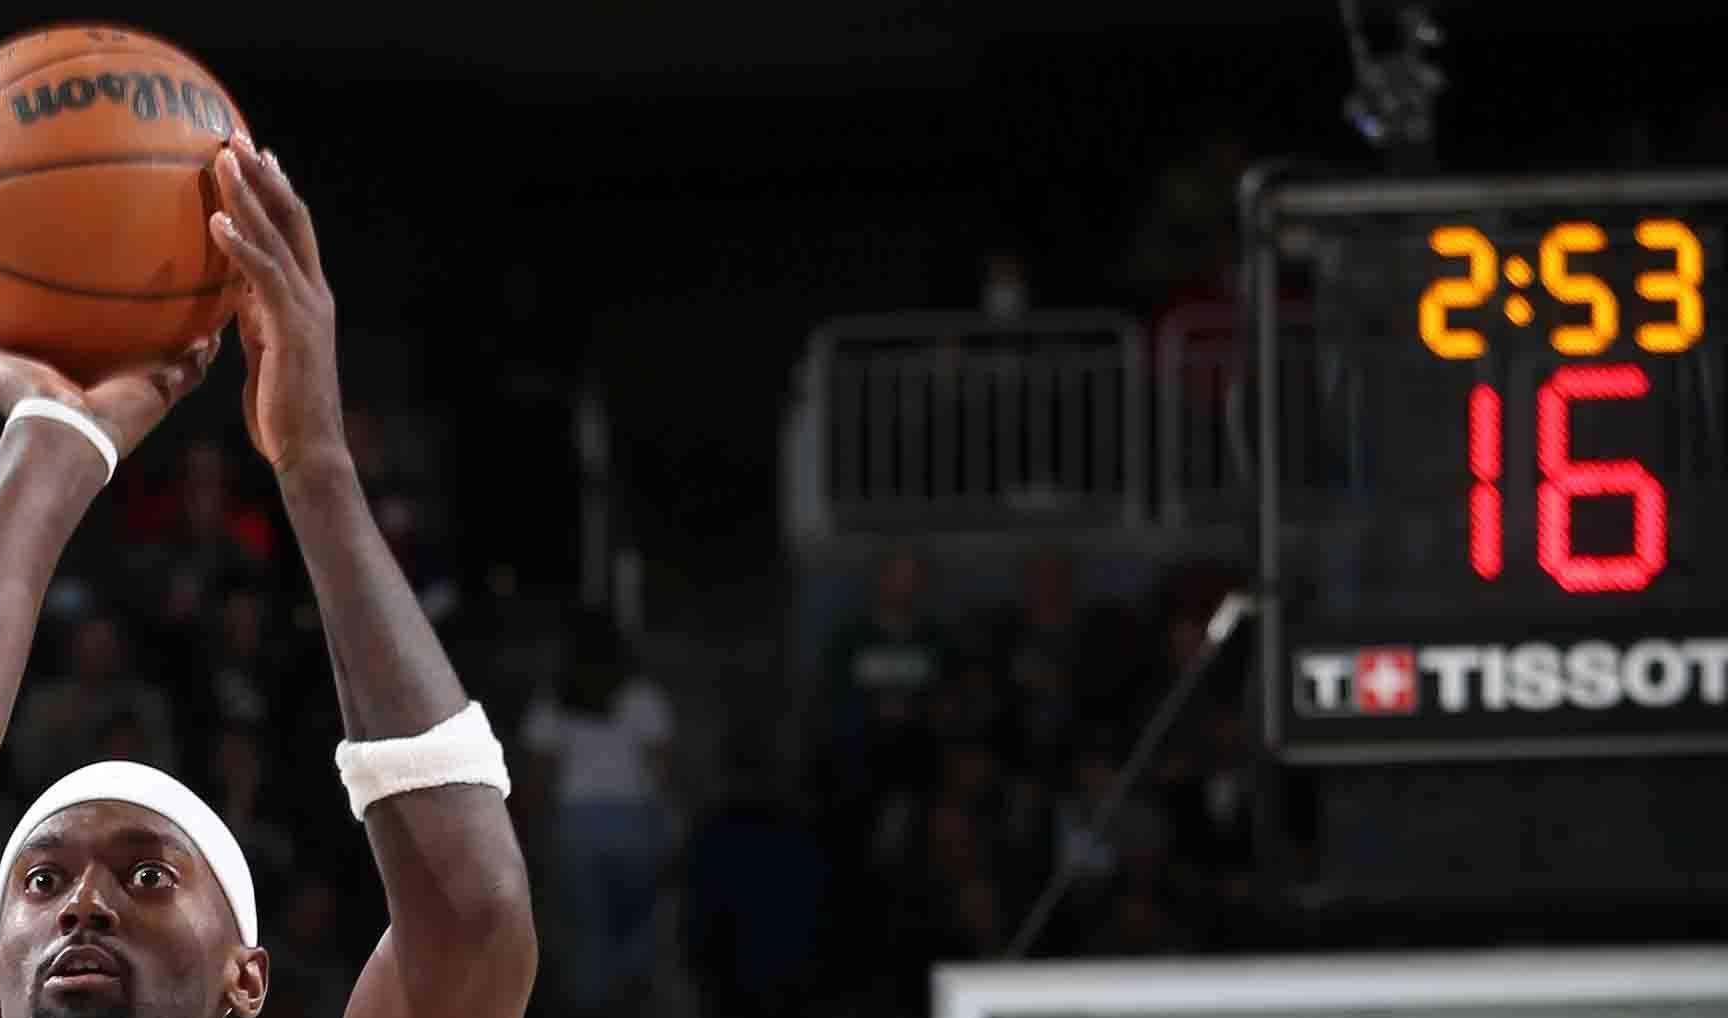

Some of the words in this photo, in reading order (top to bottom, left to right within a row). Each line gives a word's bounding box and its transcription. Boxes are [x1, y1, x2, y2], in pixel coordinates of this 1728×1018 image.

[10, 70, 232, 141] Wilson
[1418, 216, 1706, 361] 2:53
[1468, 363, 1669, 593] 16
[1419, 637, 1728, 713] TISSOT
